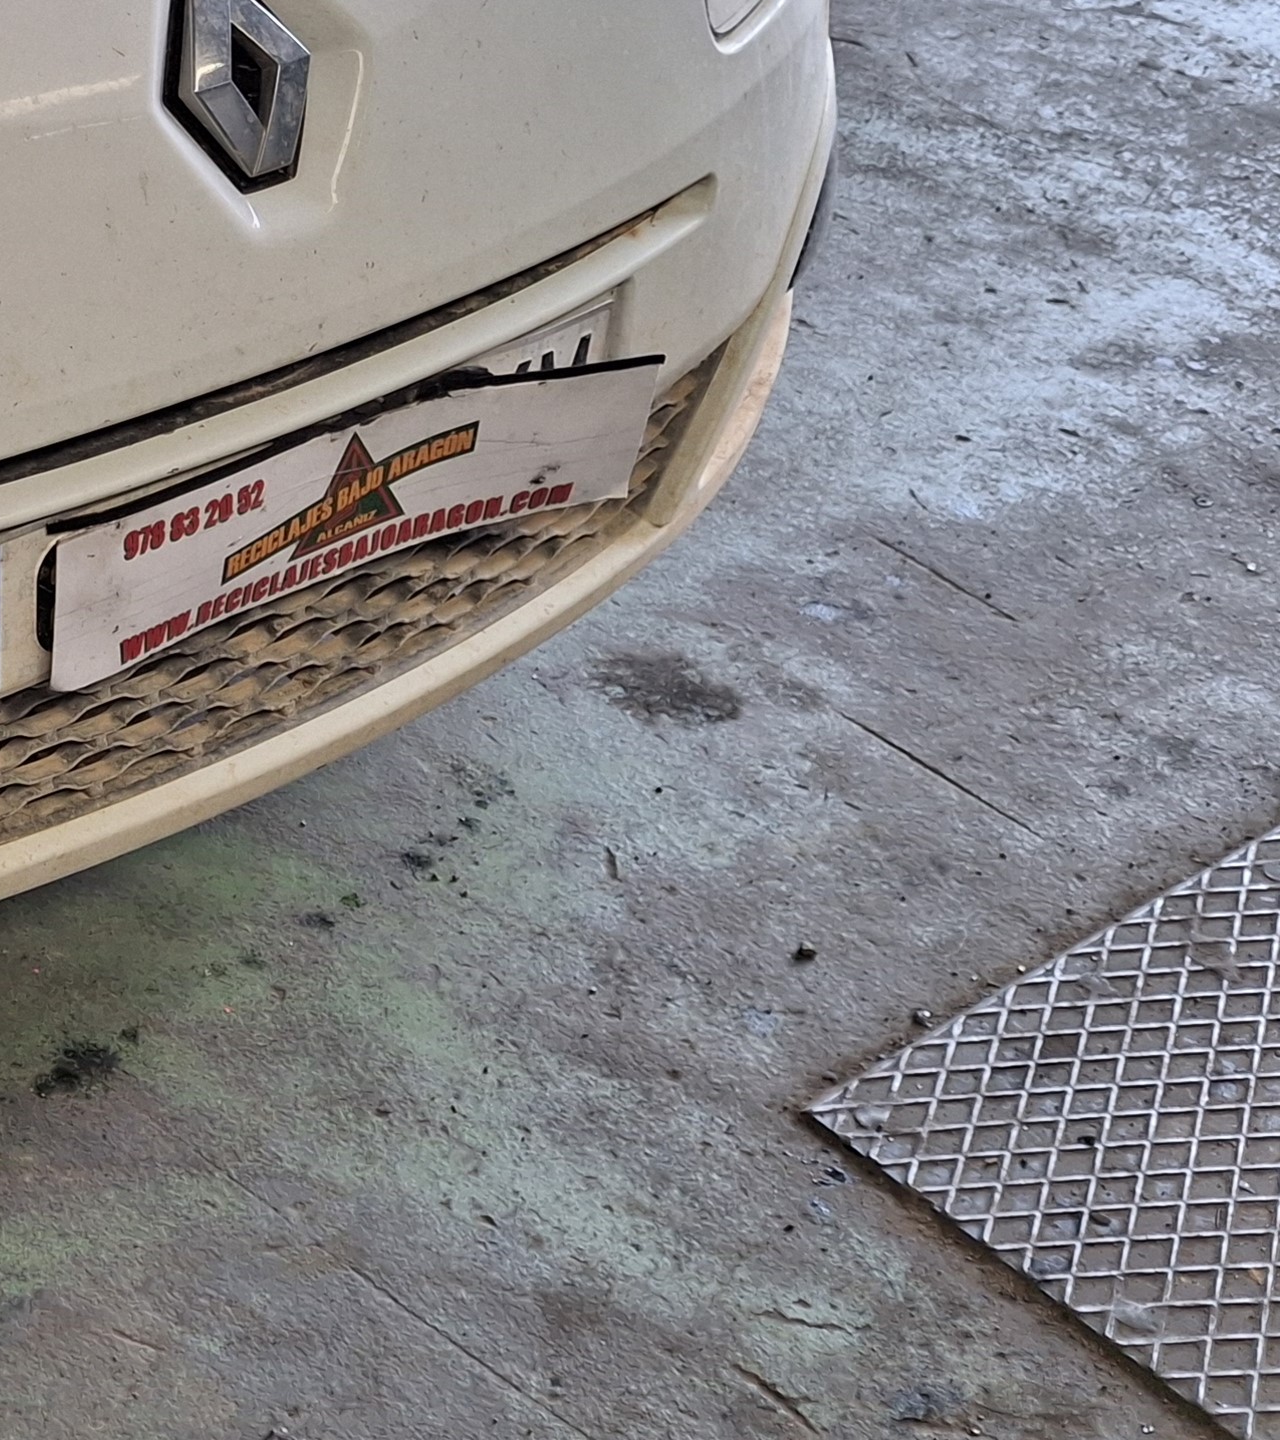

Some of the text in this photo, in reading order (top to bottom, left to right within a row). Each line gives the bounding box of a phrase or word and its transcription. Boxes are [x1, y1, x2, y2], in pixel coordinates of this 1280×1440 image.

[120, 481, 575, 665] WWW.RECICLAJESBAJOARAGON.COM
[124, 478, 266, 561] 978 83 20 52
[226, 426, 476, 579] RECICLAJES BAJO ARAGÓN
